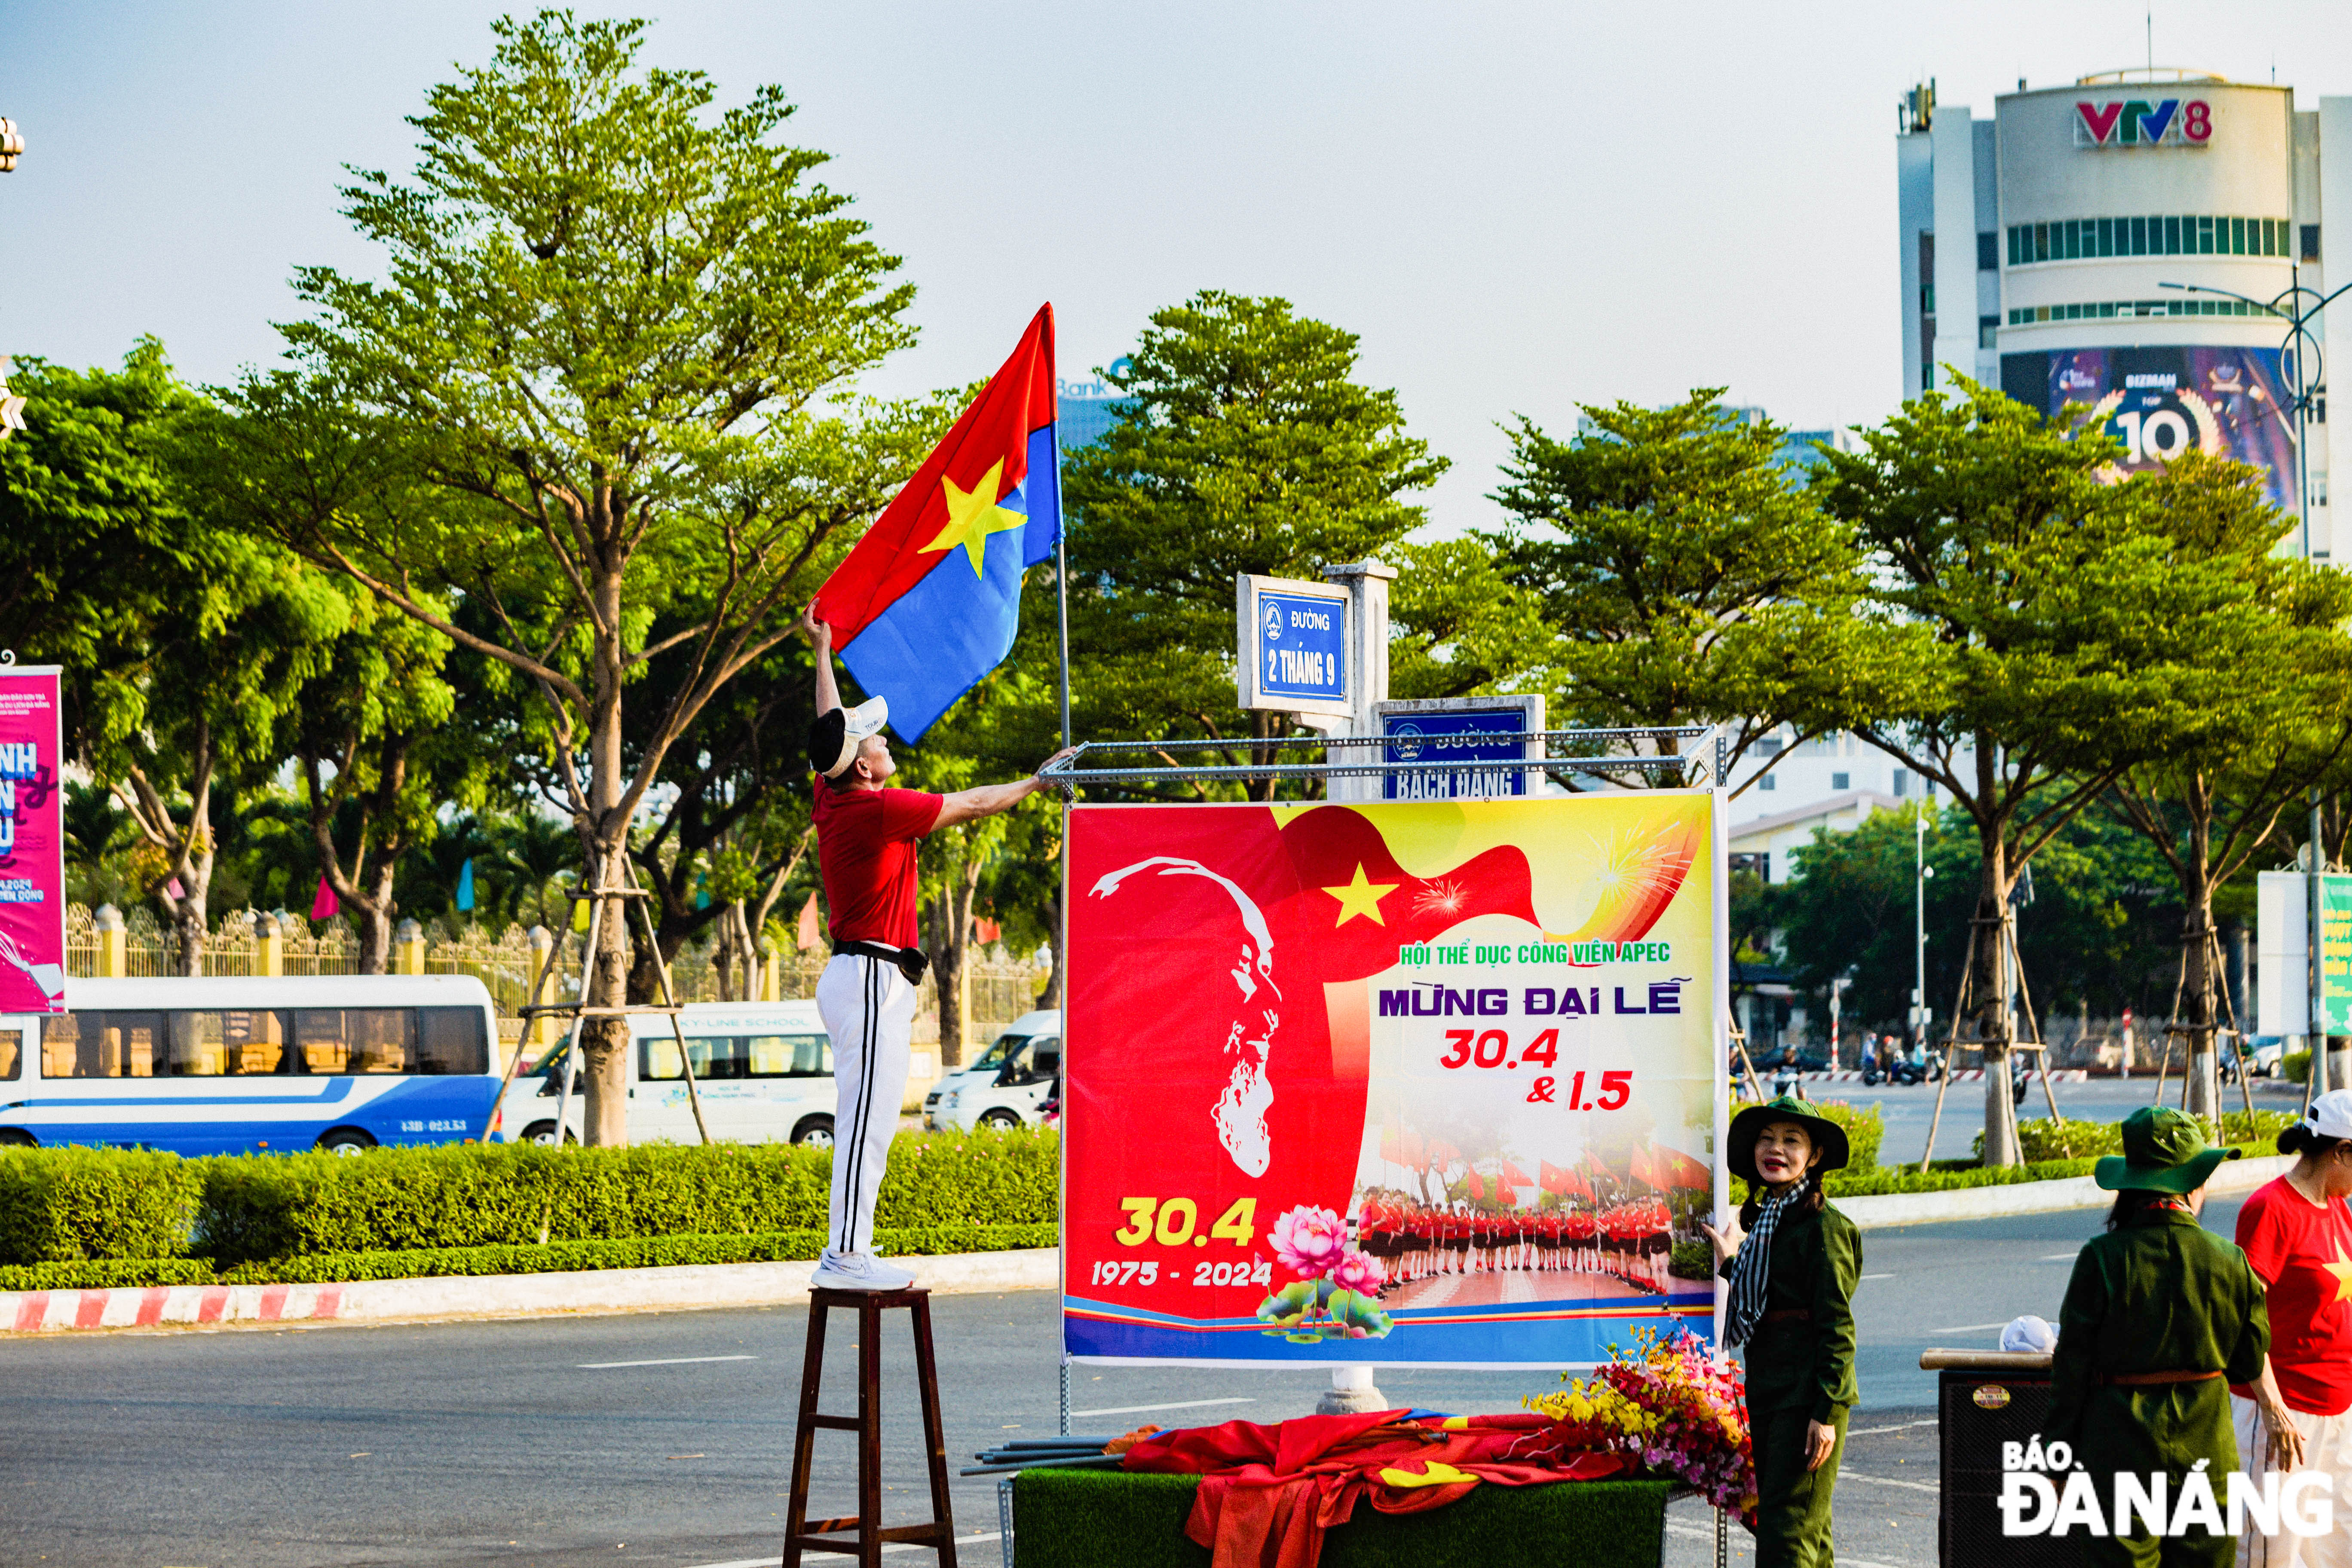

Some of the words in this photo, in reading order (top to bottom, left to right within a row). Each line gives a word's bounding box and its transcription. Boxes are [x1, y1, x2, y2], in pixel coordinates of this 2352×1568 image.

[2076, 98, 2212, 144] VTV8
[2116, 410, 2190, 464] 10
[1291, 608, 1330, 631] ĐƯỜNG
[1268, 649, 1277, 682] 2
[1280, 641, 1323, 685] THÁNG
[1326, 653, 1335, 686] 9
[1402, 943, 1430, 969] HỘI
[1437, 938, 1470, 964] THỂ
[1476, 946, 1511, 968] DỤC
[1518, 941, 1567, 963] CÔNG
[1573, 940, 1615, 962] VIÊN
[1621, 943, 1670, 962] APEC
[1379, 982, 1507, 1016] MỪNG
[1615, 977, 1692, 1014] LỄ
[745, 1018, 810, 1027] SCHOOL
[1440, 1029, 1559, 1069] 30.4
[1527, 1076, 1556, 1103] &
[1569, 1071, 1632, 1111] 1.5
[1115, 1197, 1257, 1247] 30.4
[1092, 1262, 1159, 1286] 1975
[1193, 1262, 1272, 1286] 2024
